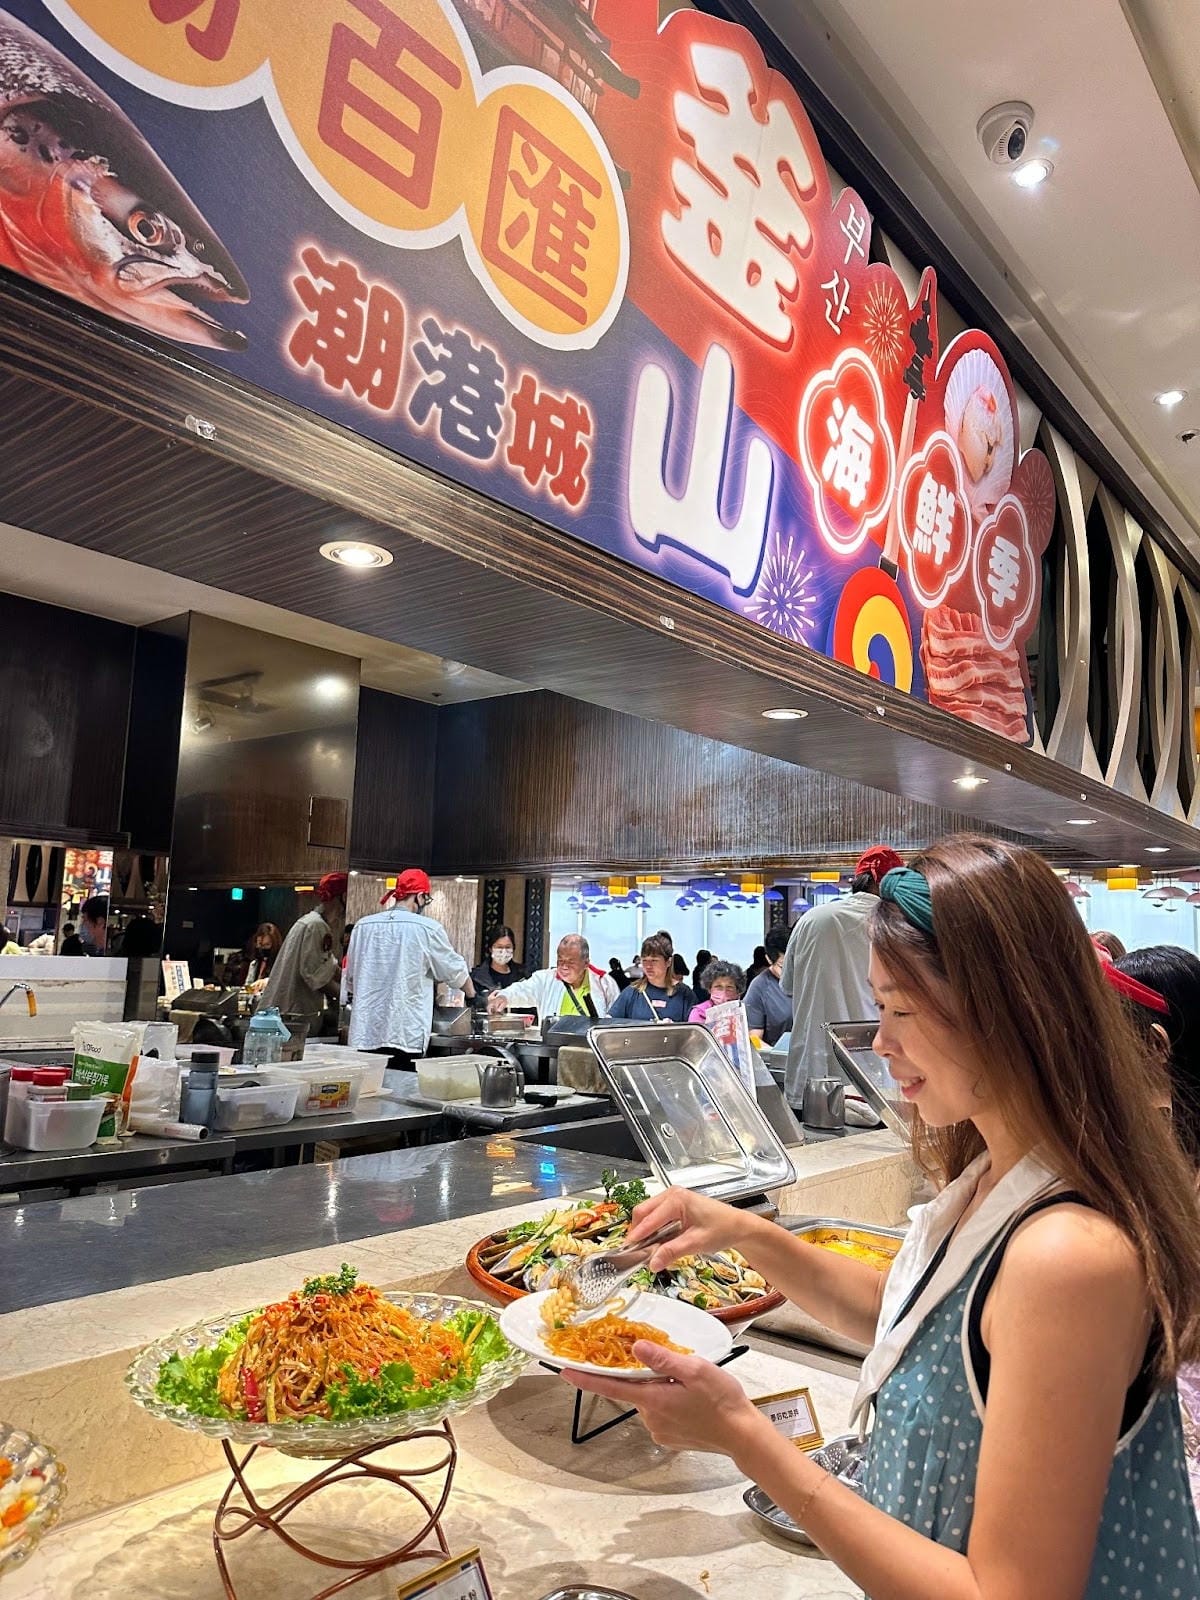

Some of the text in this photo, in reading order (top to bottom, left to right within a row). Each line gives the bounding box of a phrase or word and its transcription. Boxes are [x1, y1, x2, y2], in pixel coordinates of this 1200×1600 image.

[288, 246, 594, 507] 潮港城
[630, 41, 815, 595] 釜山
[820, 203, 866, 335] 부산
[821, 397, 1021, 608] 海鮮季
